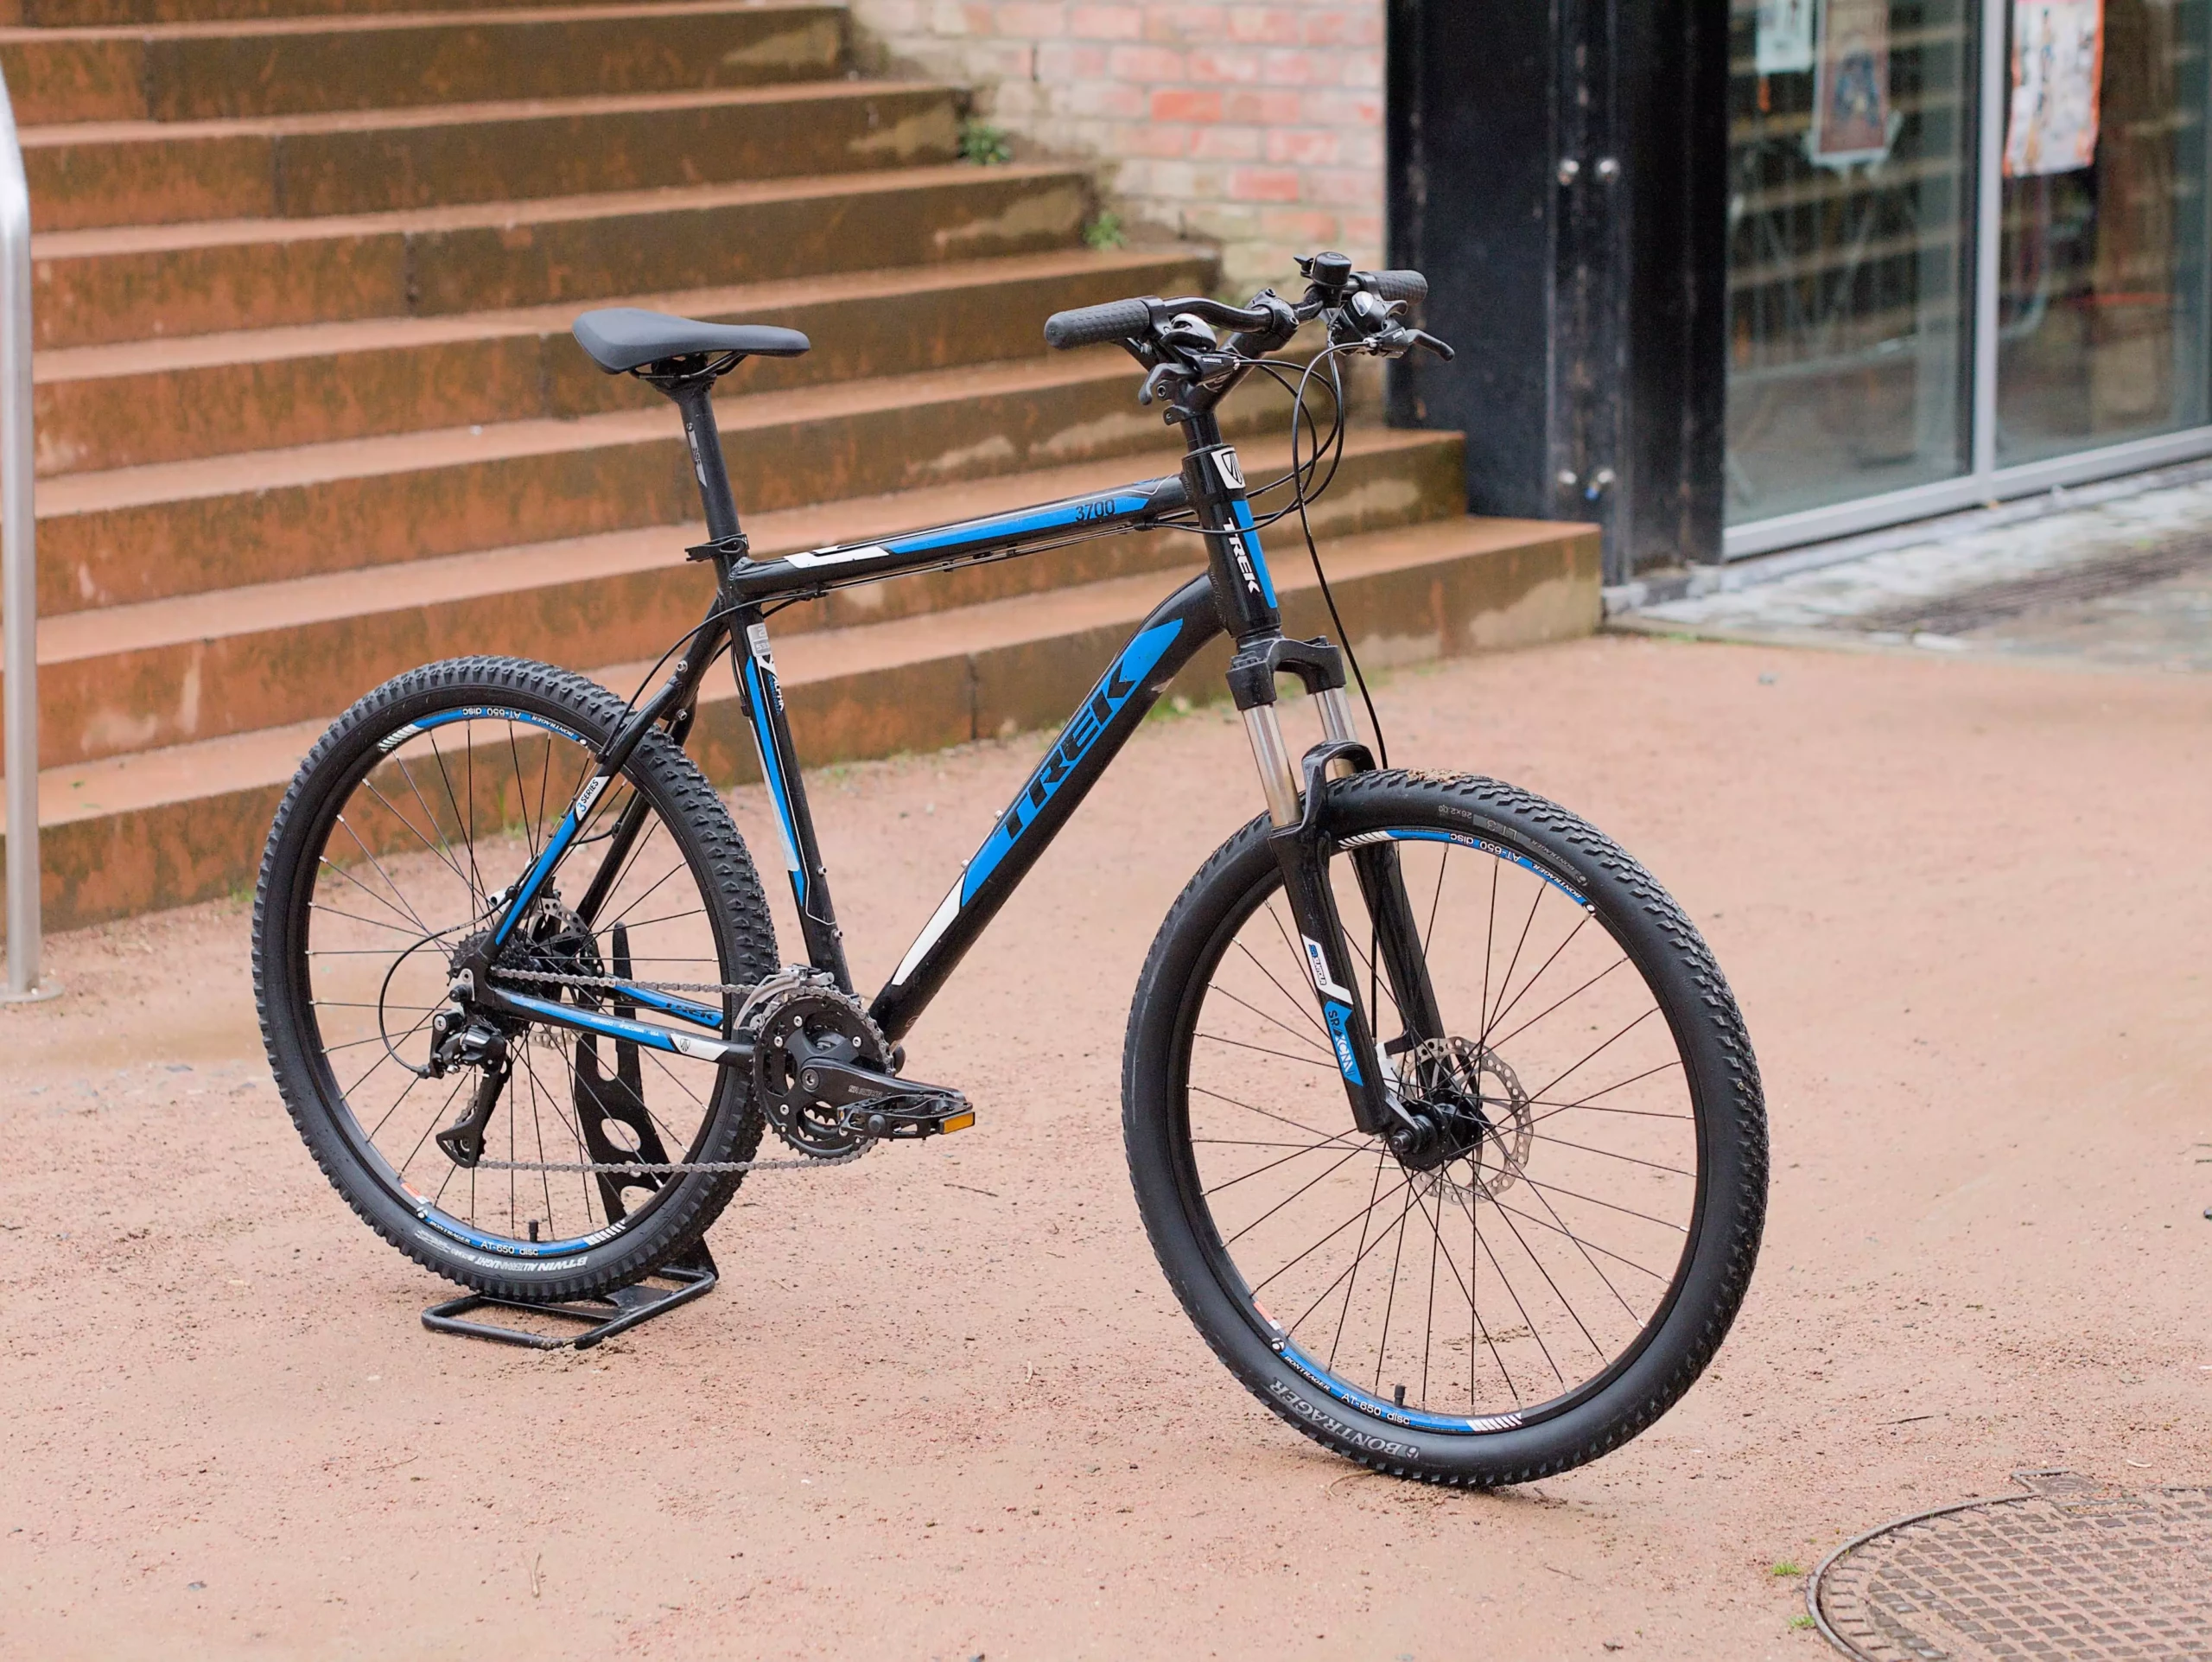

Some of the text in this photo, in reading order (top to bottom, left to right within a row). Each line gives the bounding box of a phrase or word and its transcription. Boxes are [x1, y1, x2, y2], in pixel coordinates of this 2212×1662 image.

[1075, 499, 1116, 521] 3700
[1223, 516, 1261, 594] TREK
[461, 707, 575, 737] BONTRAGER AT-650 disc
[994, 659, 1136, 840] TREK
[576, 779, 599, 812] 3 SERIES
[1449, 833, 1583, 899] BONTRAGER AT-650 disc
[429, 1219, 471, 1245] BONTRAGER
[480, 1240, 515, 1255] AT-650
[519, 1245, 539, 1256] disc
[1269, 1378, 1403, 1455] BONTRAGER
[1283, 1355, 1411, 1425] BONTRAGER AT-650 disc
